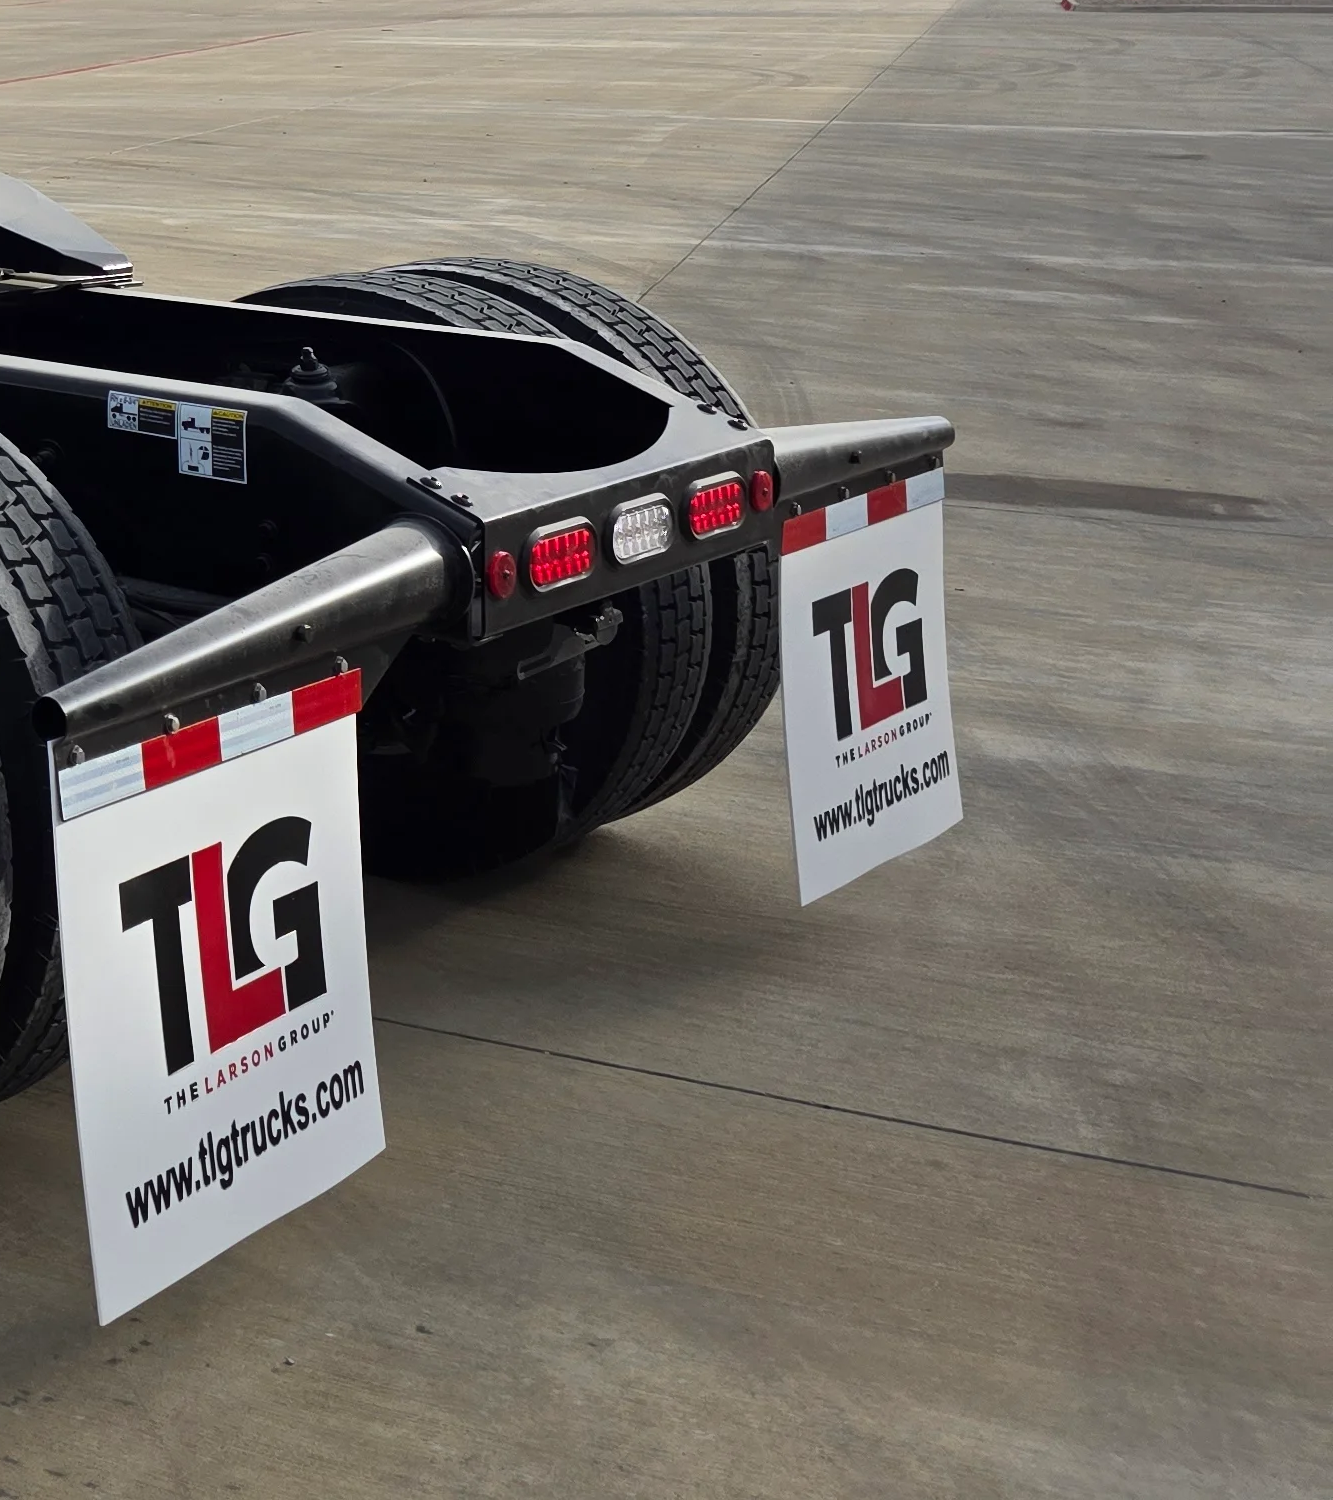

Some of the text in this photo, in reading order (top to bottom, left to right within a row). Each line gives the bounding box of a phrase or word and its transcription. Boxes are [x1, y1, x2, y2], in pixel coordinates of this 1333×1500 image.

[812, 567, 928, 742] TLG
[813, 750, 950, 842] www.tlgtrucks.com
[835, 714, 930, 768] THE LARSON GROUP
[118, 816, 327, 1076] TLG
[163, 1012, 331, 1115] THE LARSON GROUP
[125, 1059, 365, 1229] www.tlgtrucks.com
